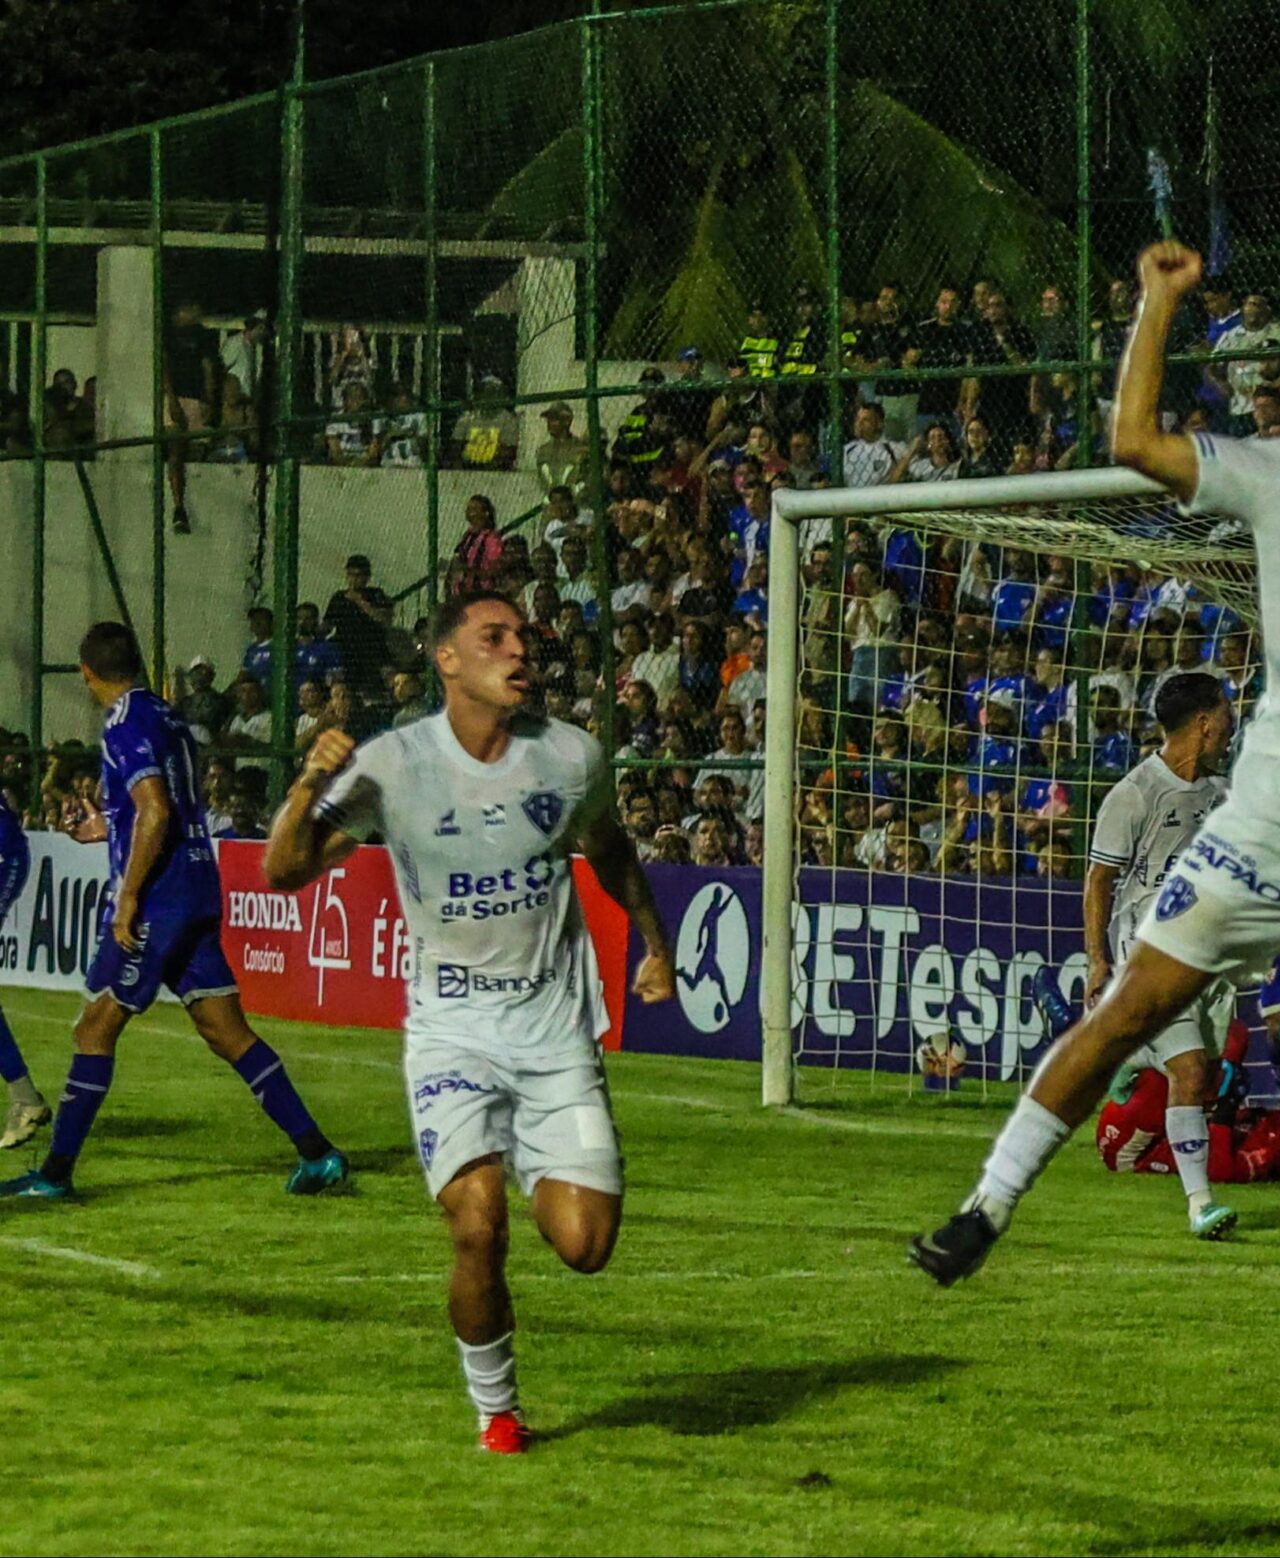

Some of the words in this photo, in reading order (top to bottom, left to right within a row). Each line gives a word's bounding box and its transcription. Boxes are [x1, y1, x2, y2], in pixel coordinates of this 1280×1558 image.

[449, 868, 517, 898] Bet
[228, 891, 303, 933] HONDA
[472, 891, 549, 920] Sorte
[243, 942, 286, 975] Consórcio
